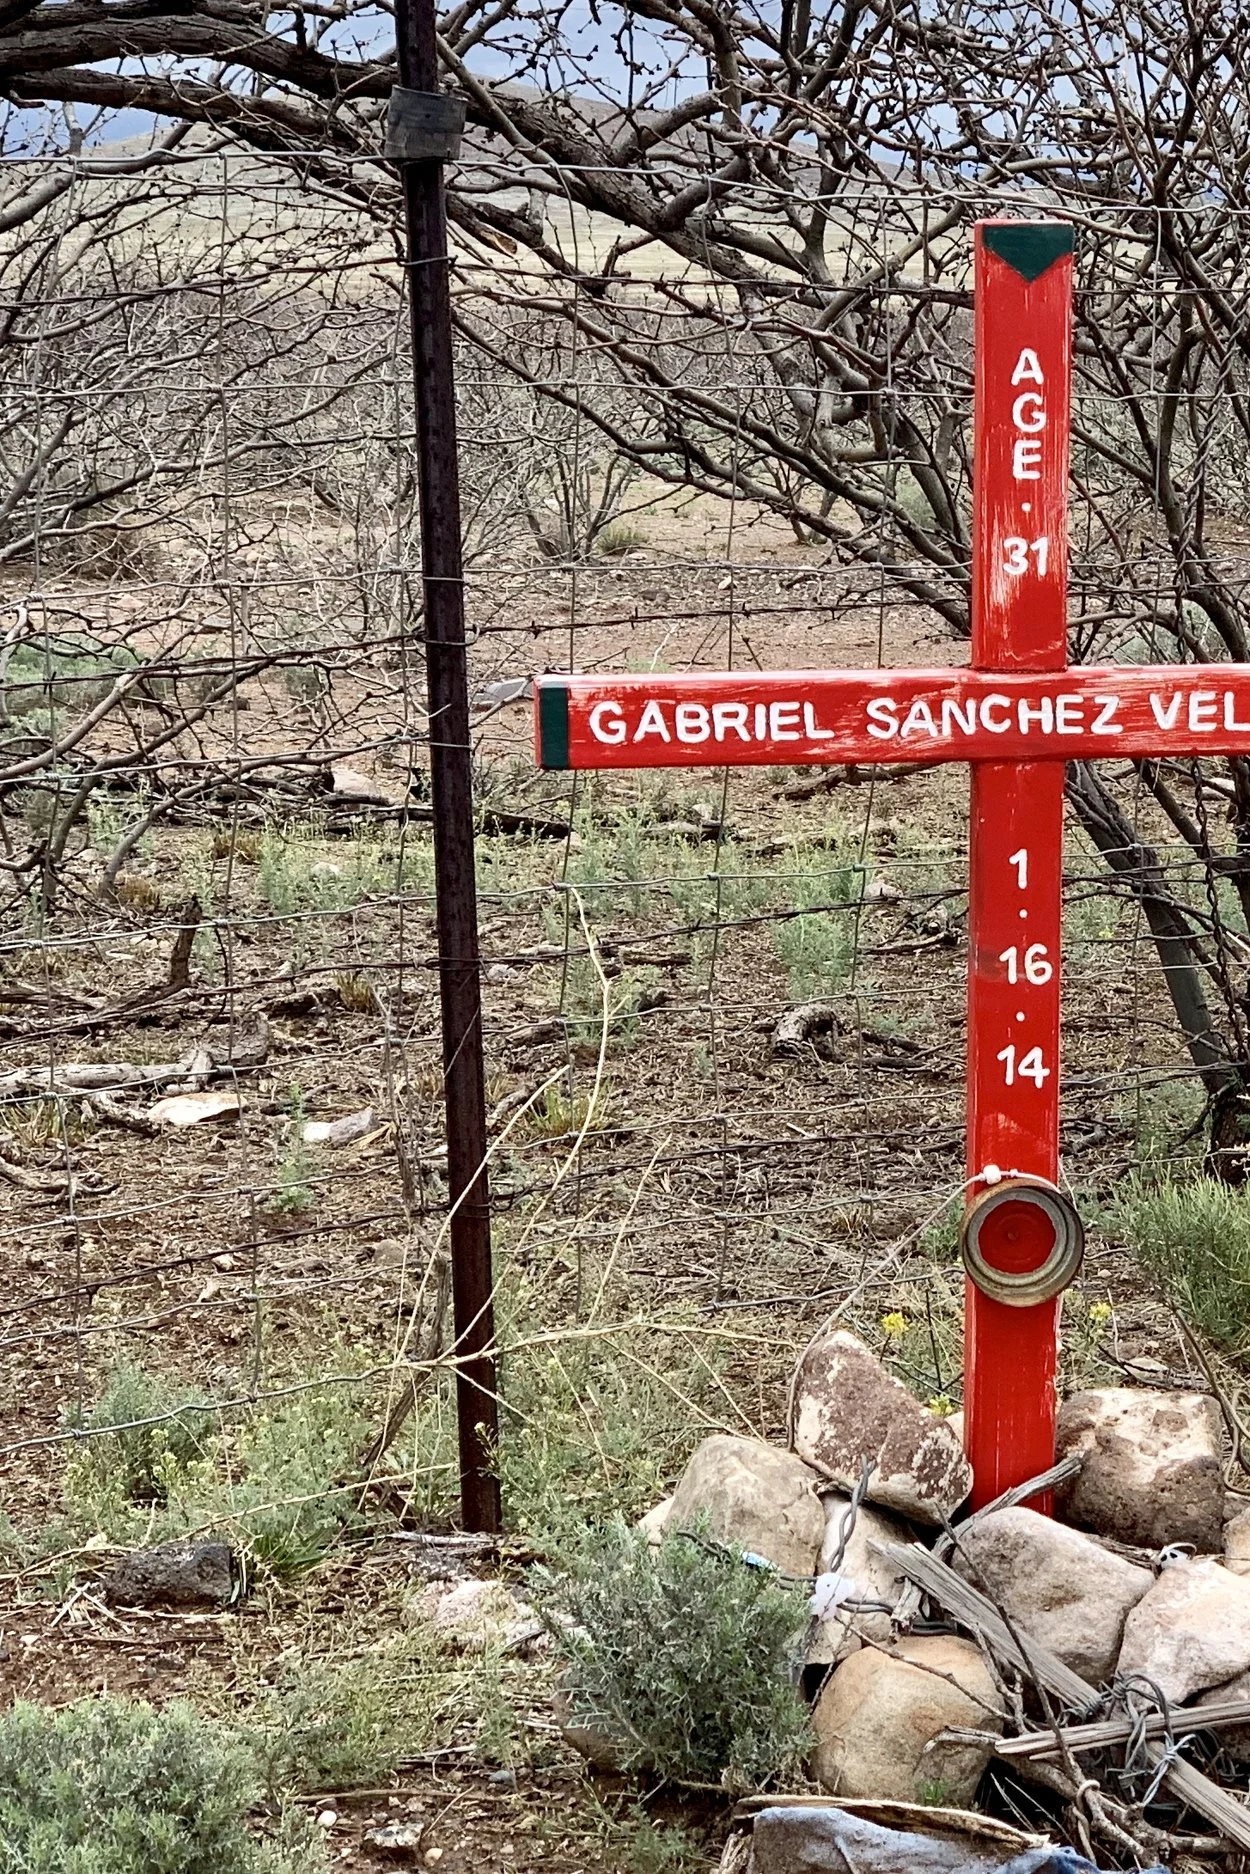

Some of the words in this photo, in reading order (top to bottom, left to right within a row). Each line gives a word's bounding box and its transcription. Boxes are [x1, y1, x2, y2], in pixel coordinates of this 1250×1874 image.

[1010, 347, 1048, 481] AGE
[1002, 535, 1050, 577] 31
[588, 699, 836, 745] GABRIEL
[865, 693, 1126, 741] SANCHEZ
